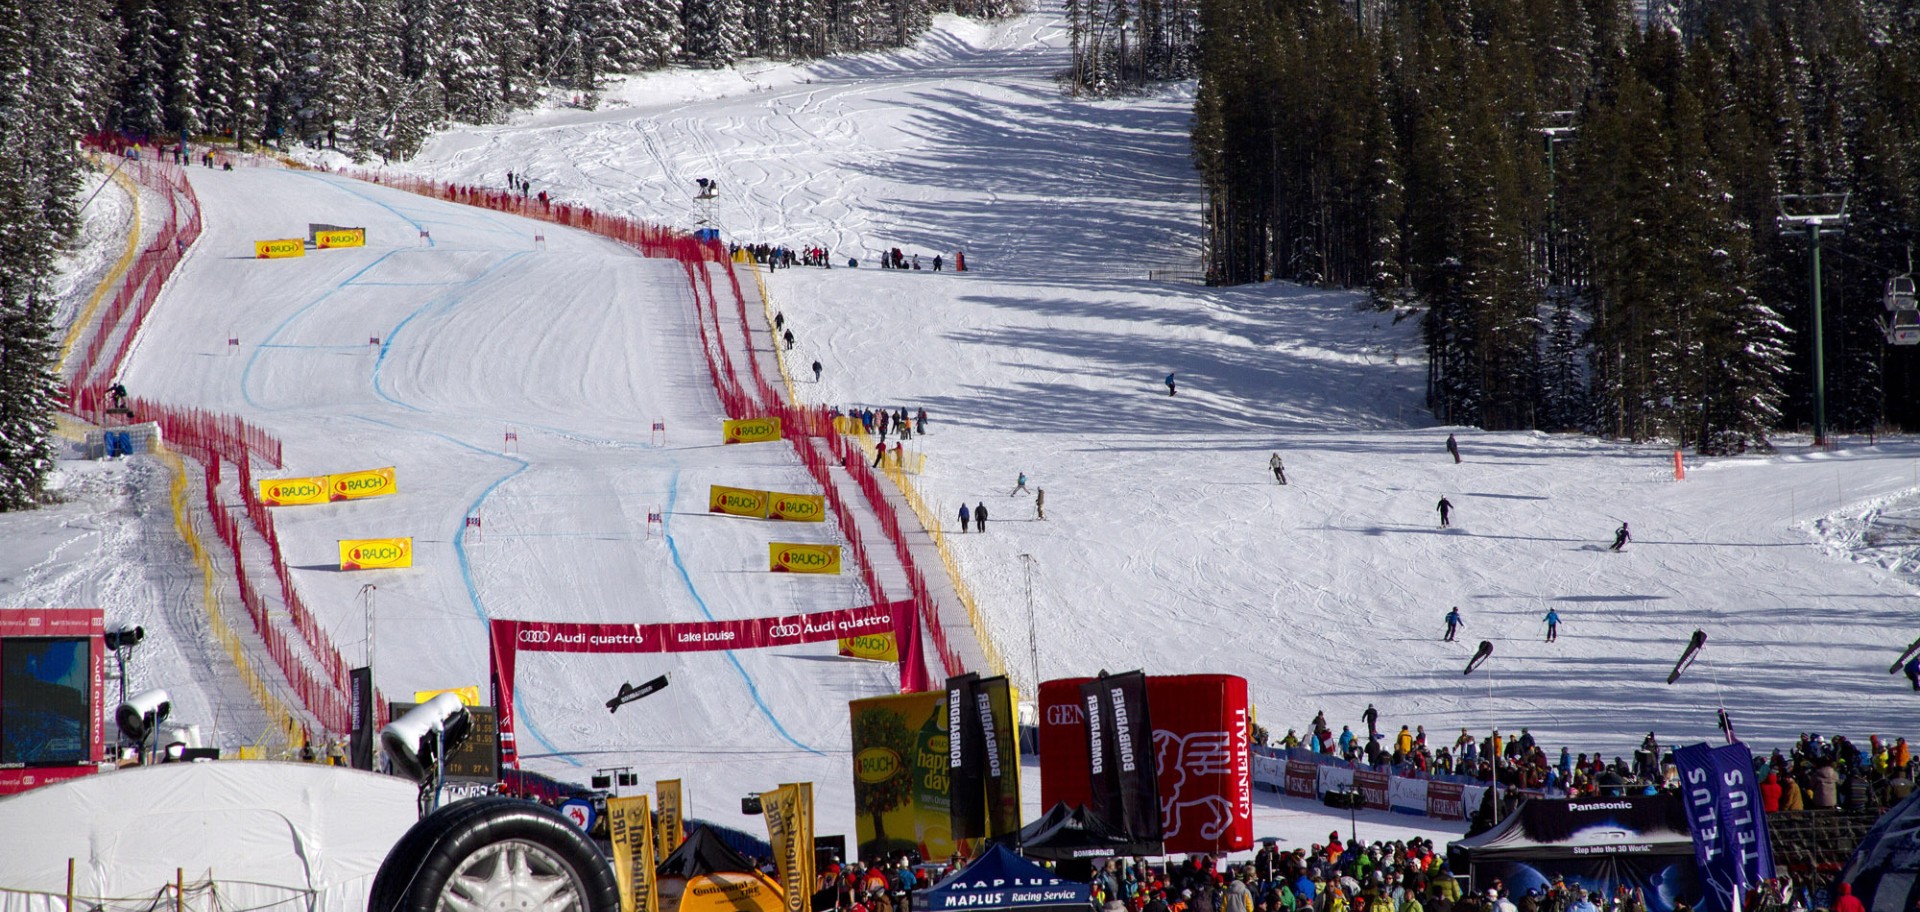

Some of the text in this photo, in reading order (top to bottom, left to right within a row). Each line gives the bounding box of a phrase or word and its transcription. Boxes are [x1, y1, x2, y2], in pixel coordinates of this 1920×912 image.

[331, 235, 355, 243] RAUCH
[270, 245, 295, 253] RAUCH
[742, 424, 770, 436] RAUCH
[347, 478, 382, 491] RAUCH
[281, 486, 316, 497] RAUCH
[727, 495, 756, 508] RAUCH
[786, 501, 814, 513] RAUCH
[362, 547, 396, 560] RAUCH
[791, 551, 826, 566] RAUCH
[803, 614, 891, 635] Audi quattro
[553, 632, 644, 646] Audi quattro
[677, 630, 735, 643] Lake Louise
[856, 635, 885, 651] RAUCH
[93, 654, 102, 744] Audi quattro
[1047, 704, 1085, 726] GEN
[863, 756, 895, 773] RAUCH
[917, 747, 950, 775] happ
[1235, 707, 1250, 820] GENERALI
[924, 769, 951, 796] day
[1568, 800, 1633, 812] Panasonic
[1687, 767, 1722, 861] TELUS
[1723, 768, 1759, 865] TELUS
[1073, 848, 1115, 858] BOMBARDIER
[1573, 846, 1590, 855] Step
[1590, 845, 1604, 854] into
[1605, 845, 1617, 853] the
[692, 881, 749, 897] Continental
[741, 886, 760, 897] TIRE
[1011, 891, 1042, 903] Racing
[1044, 890, 1076, 901] Service
